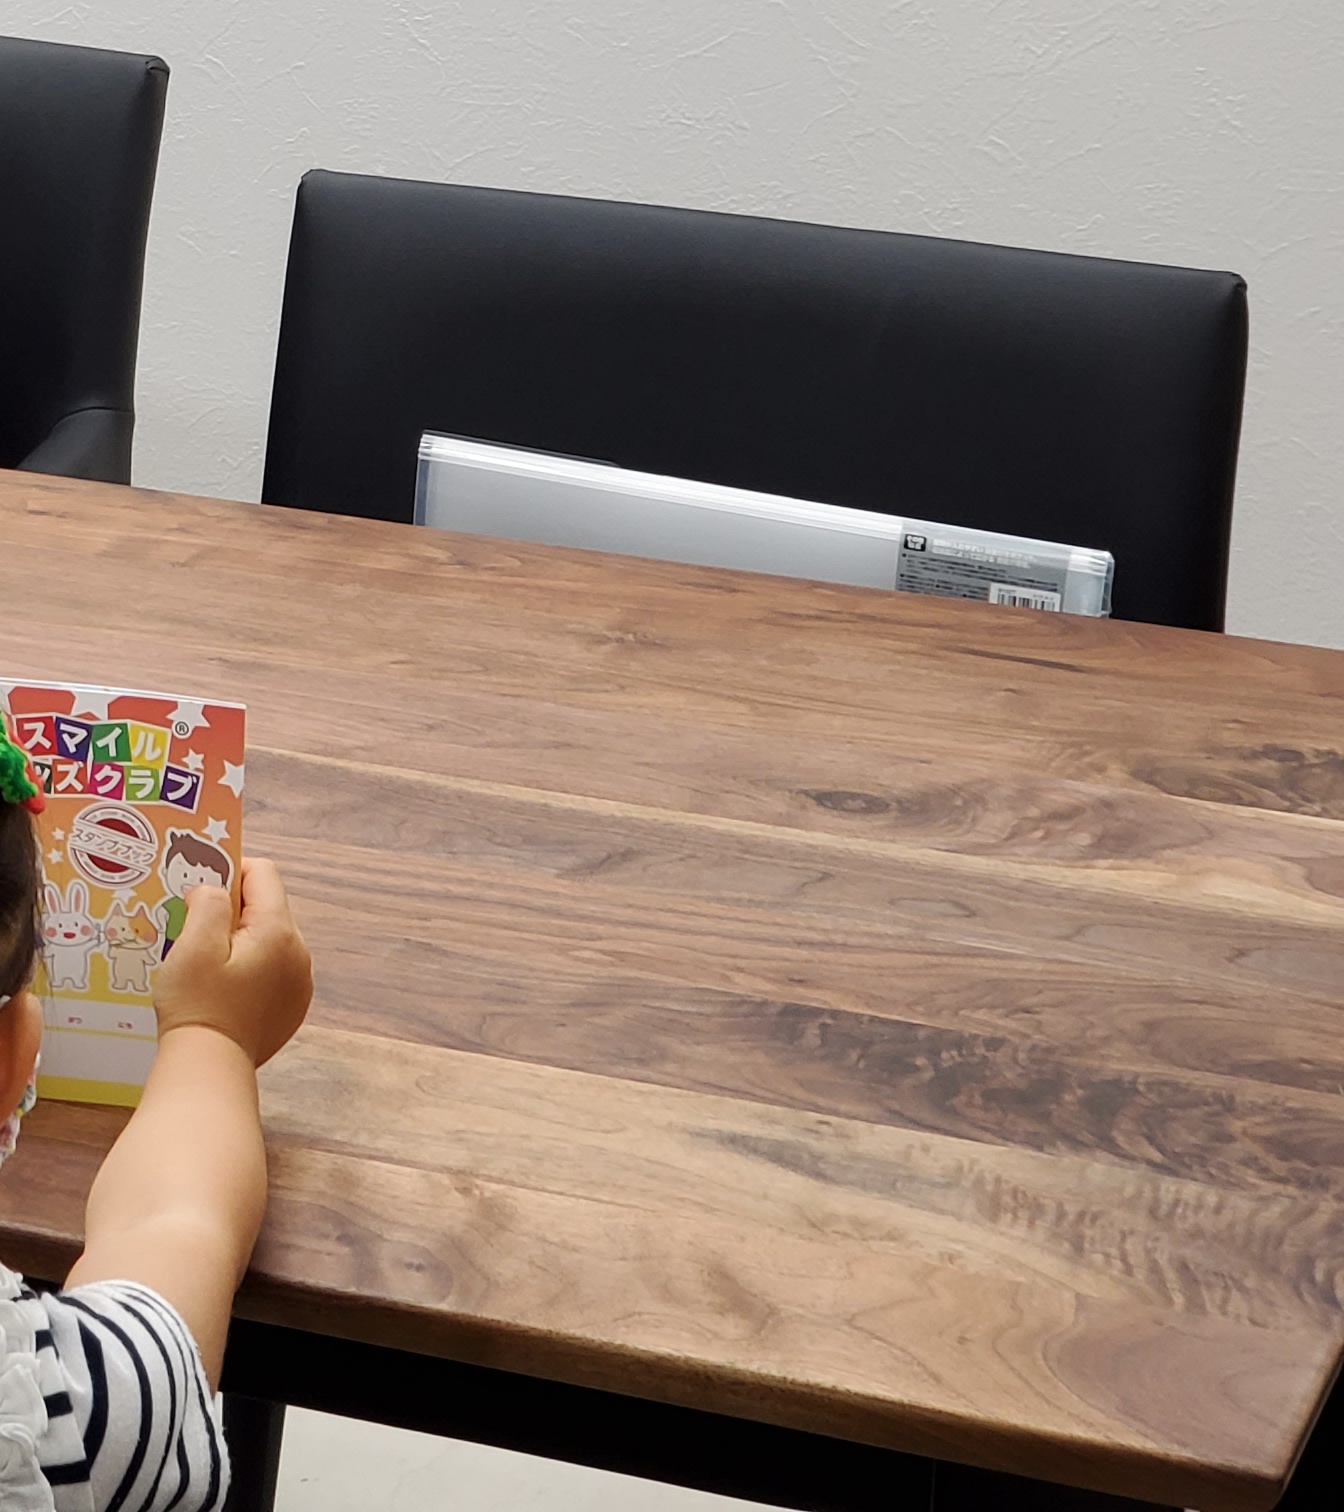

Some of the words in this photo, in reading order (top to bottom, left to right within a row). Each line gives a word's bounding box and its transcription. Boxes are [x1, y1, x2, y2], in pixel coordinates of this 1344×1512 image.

[23, 722, 162, 761] スマイル
[34, 760, 198, 800] ッズクラブ
